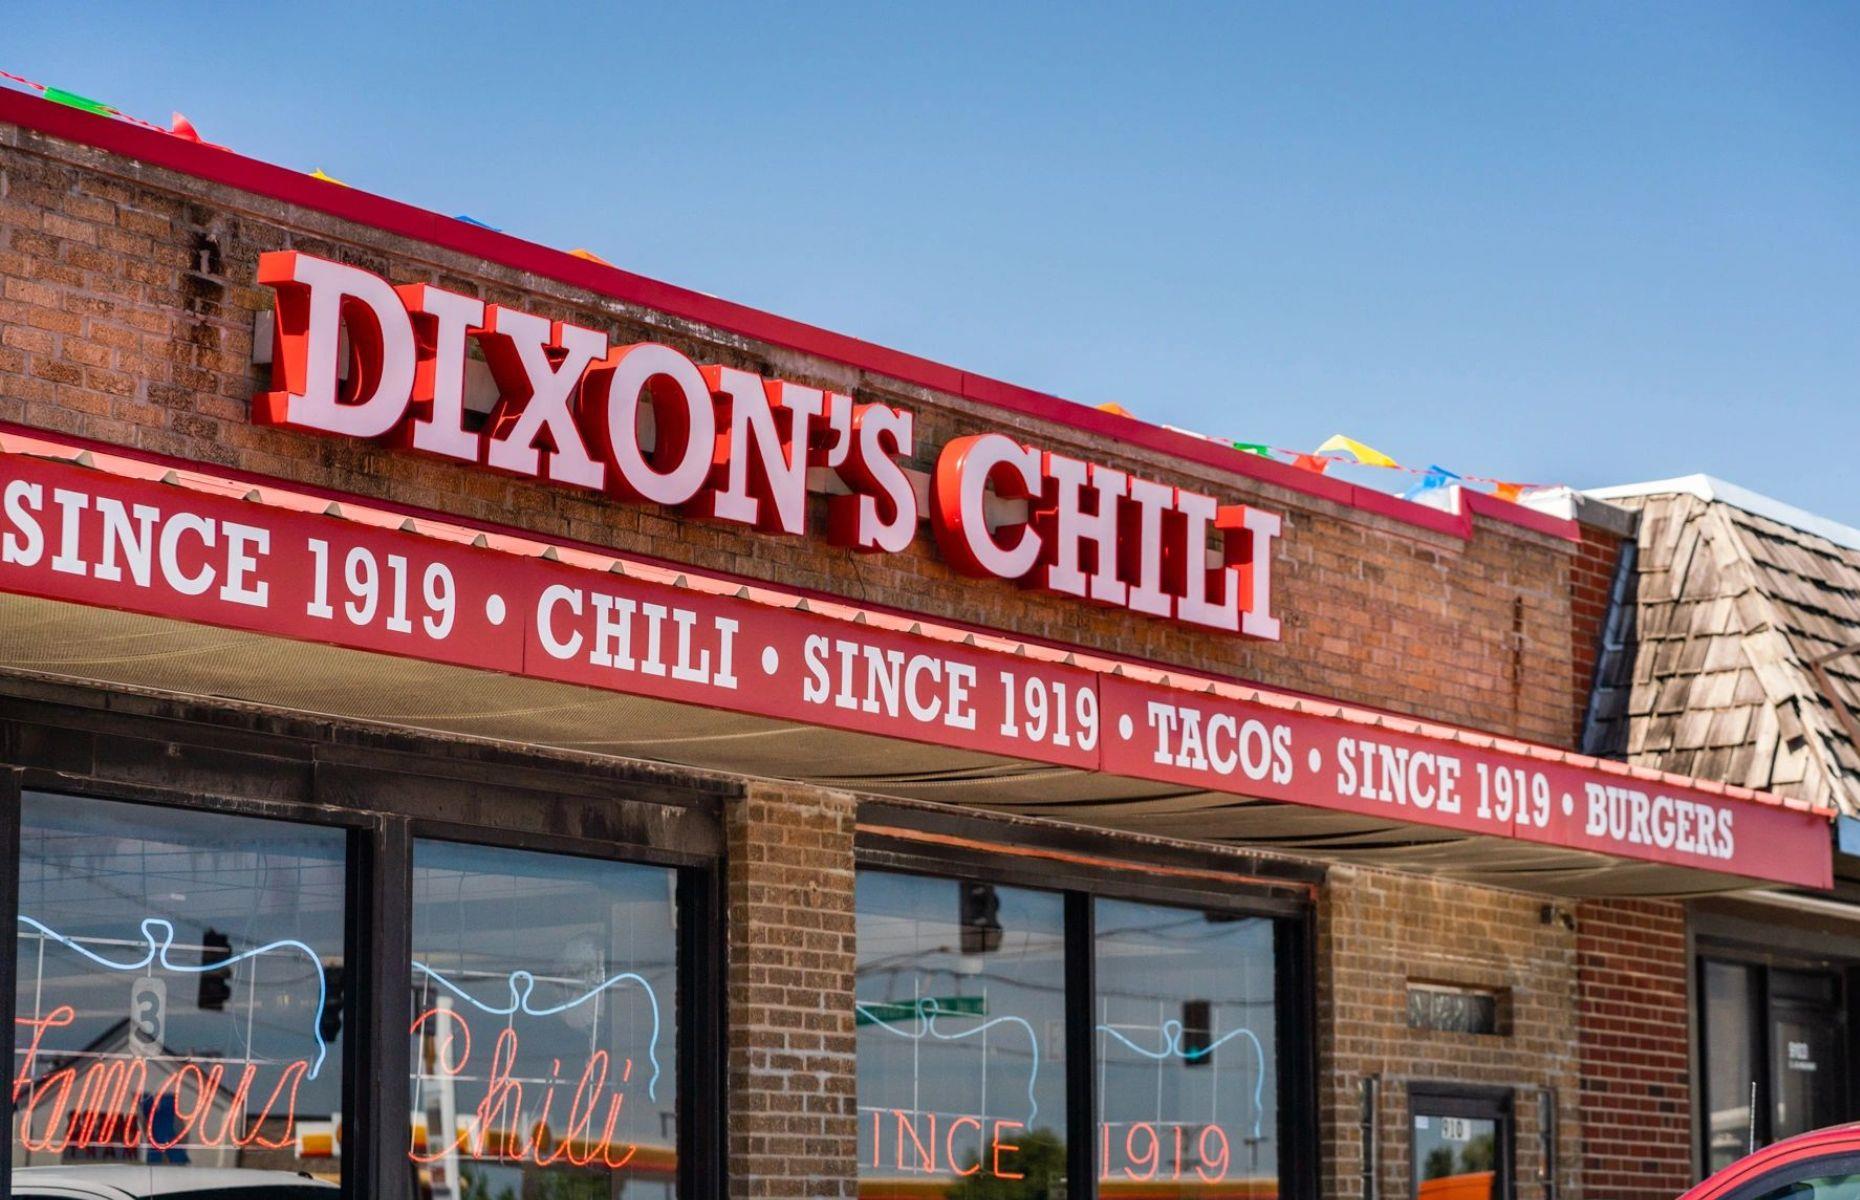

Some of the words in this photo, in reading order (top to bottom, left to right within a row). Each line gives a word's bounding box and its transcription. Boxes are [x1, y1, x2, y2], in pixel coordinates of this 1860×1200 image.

[275, 248, 918, 555] DIXON'S
[948, 432, 1282, 642] CHILI
[1, 478, 271, 609] SINCE
[306, 537, 457, 641] 1919
[536, 584, 740, 690] CHILI
[803, 633, 978, 731] SINCE
[1000, 671, 1100, 752] 1919
[1147, 700, 1294, 786] TACOS
[1336, 736, 1462, 815] SINCE
[1476, 761, 1552, 829] 1919
[1584, 781, 1735, 860] BURGERS
[12, 1004, 308, 1154] Famous
[407, 1007, 638, 1169] Chili
[871, 1107, 1025, 1181] INCE
[1100, 1122, 1231, 1184] 1919
